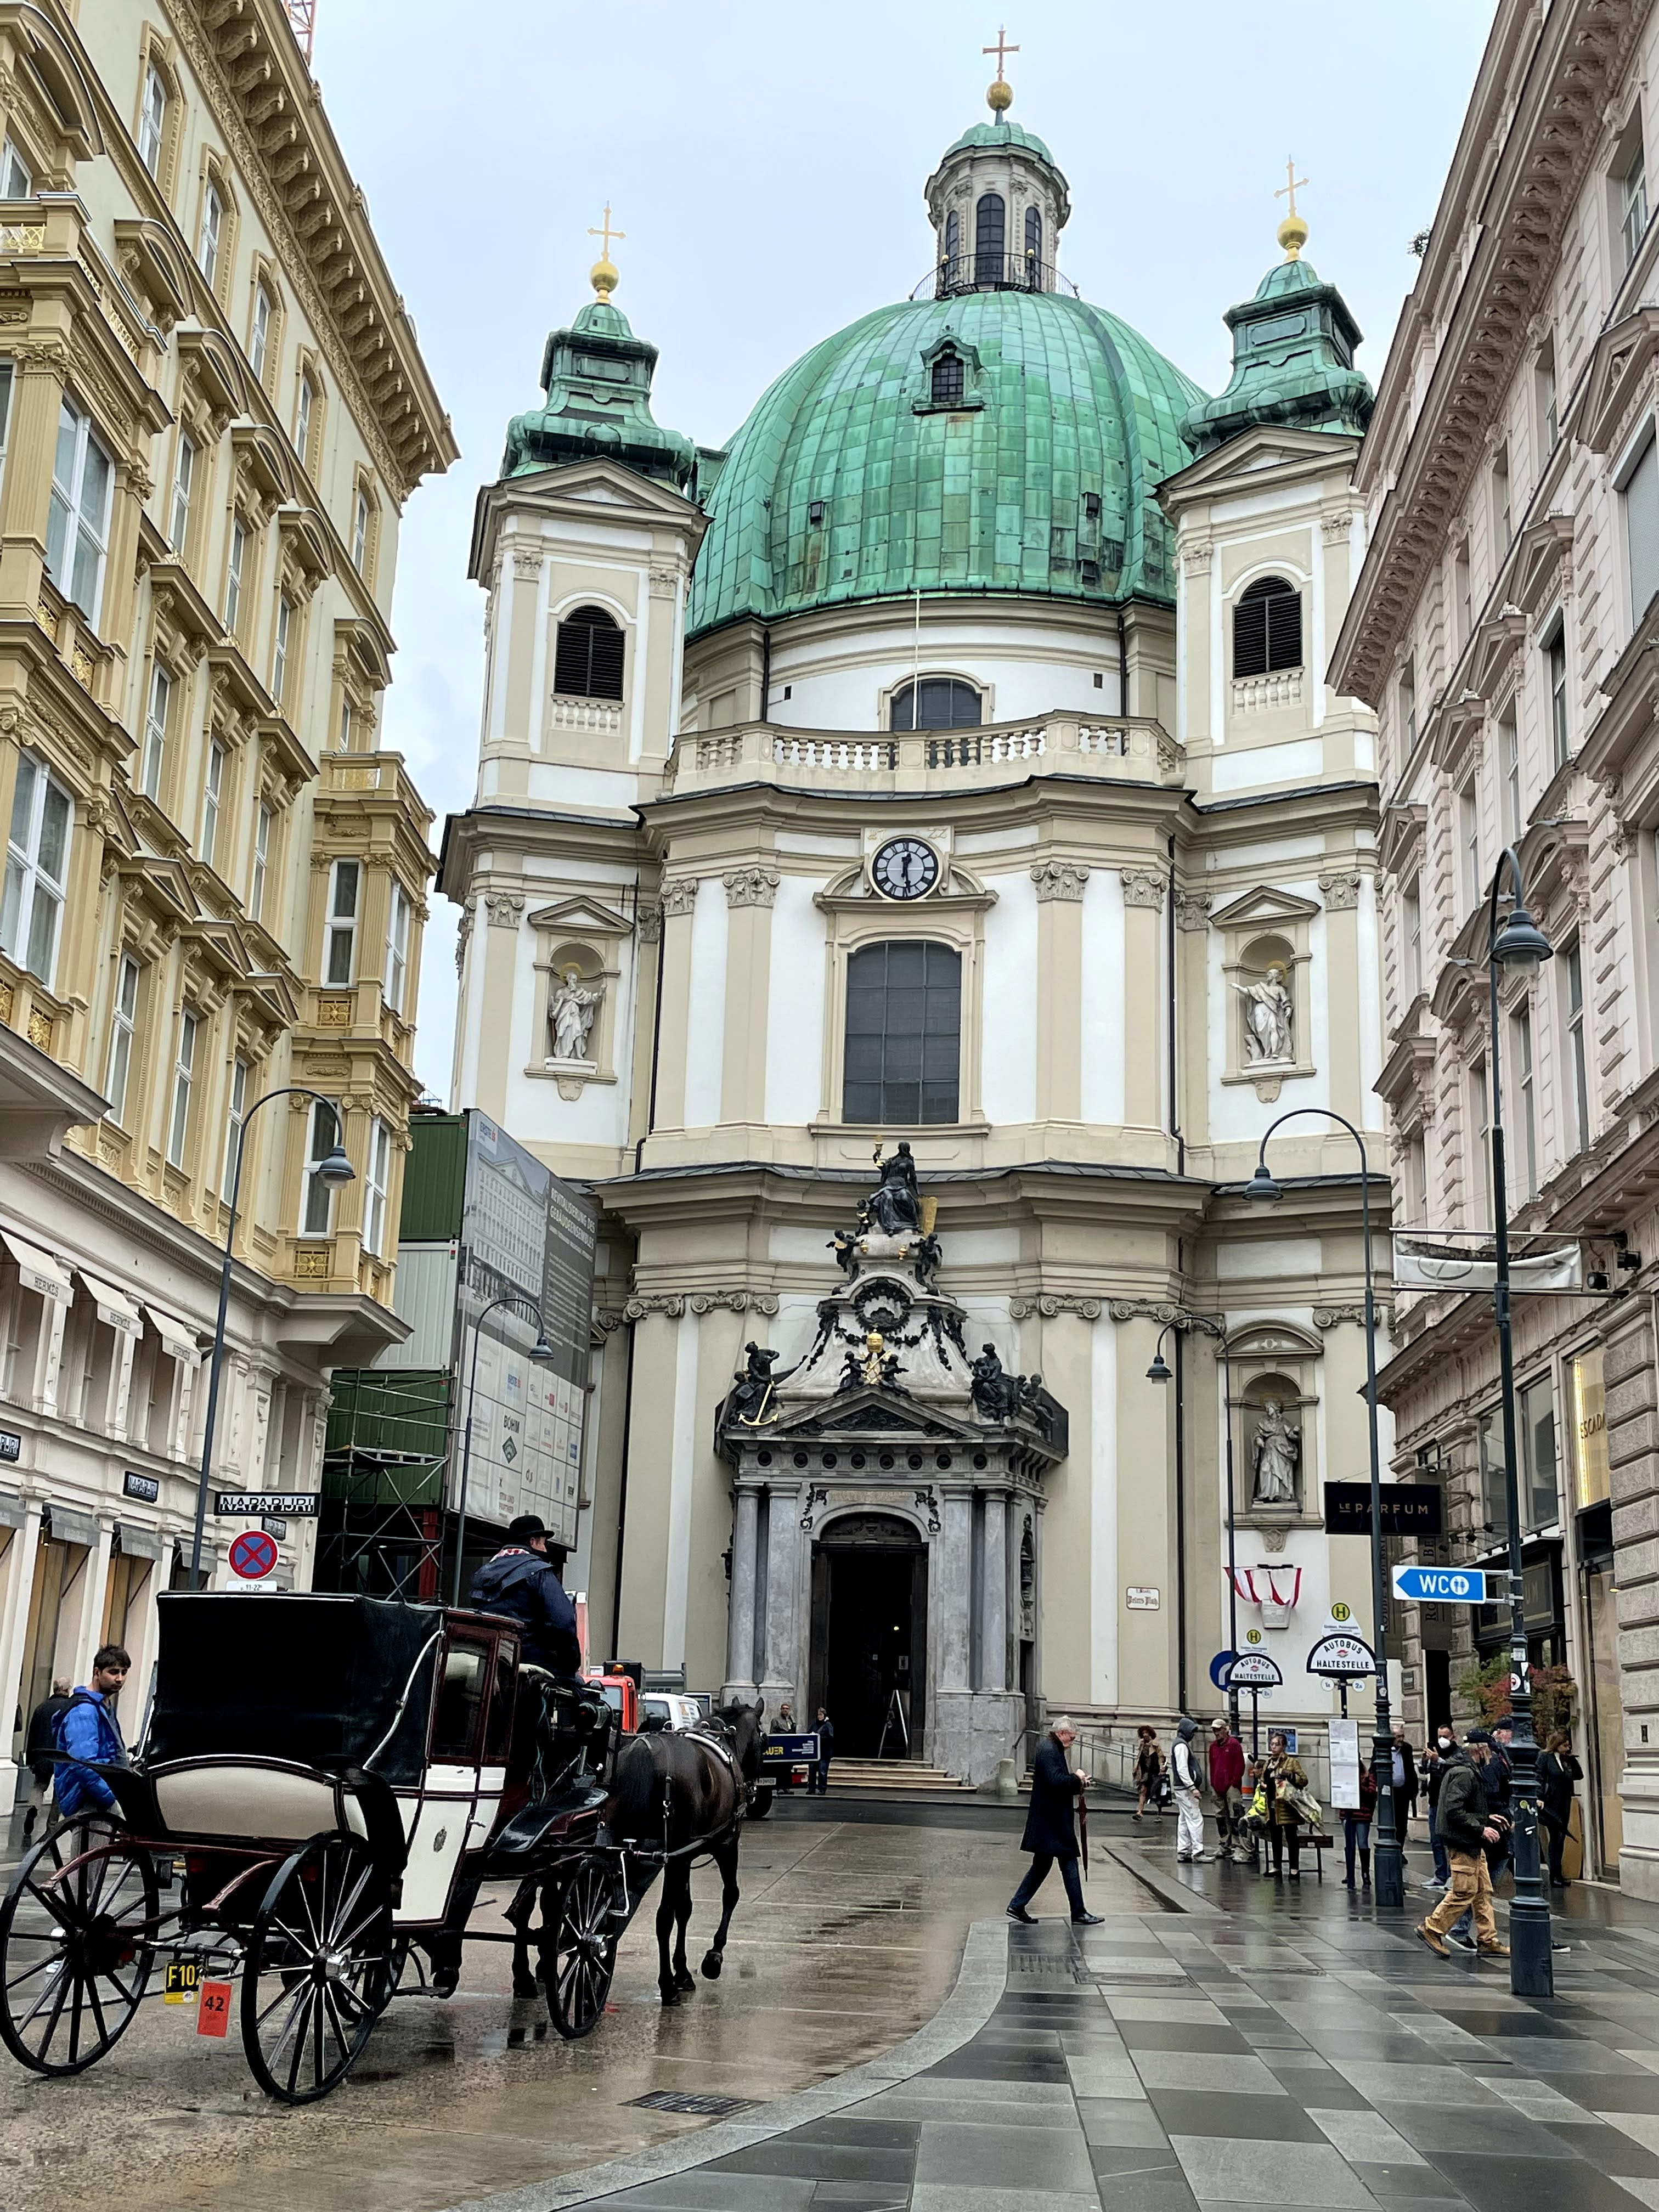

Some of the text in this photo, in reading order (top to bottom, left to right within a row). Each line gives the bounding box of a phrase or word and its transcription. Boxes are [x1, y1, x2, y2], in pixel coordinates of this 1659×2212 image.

[221, 1497, 312, 1512] NAPAPIJRI
[1355, 1503, 1428, 1514] PARFUM
[1419, 1575, 1449, 1594] WC
[1336, 1606, 1345, 1618] H
[1324, 1640, 1363, 1655] AUTOBUS
[1240, 1658, 1270, 1669] AUTOBUS
[1317, 1660, 1369, 1669] HALTESTELLE
[204, 1996, 224, 2012] 42
